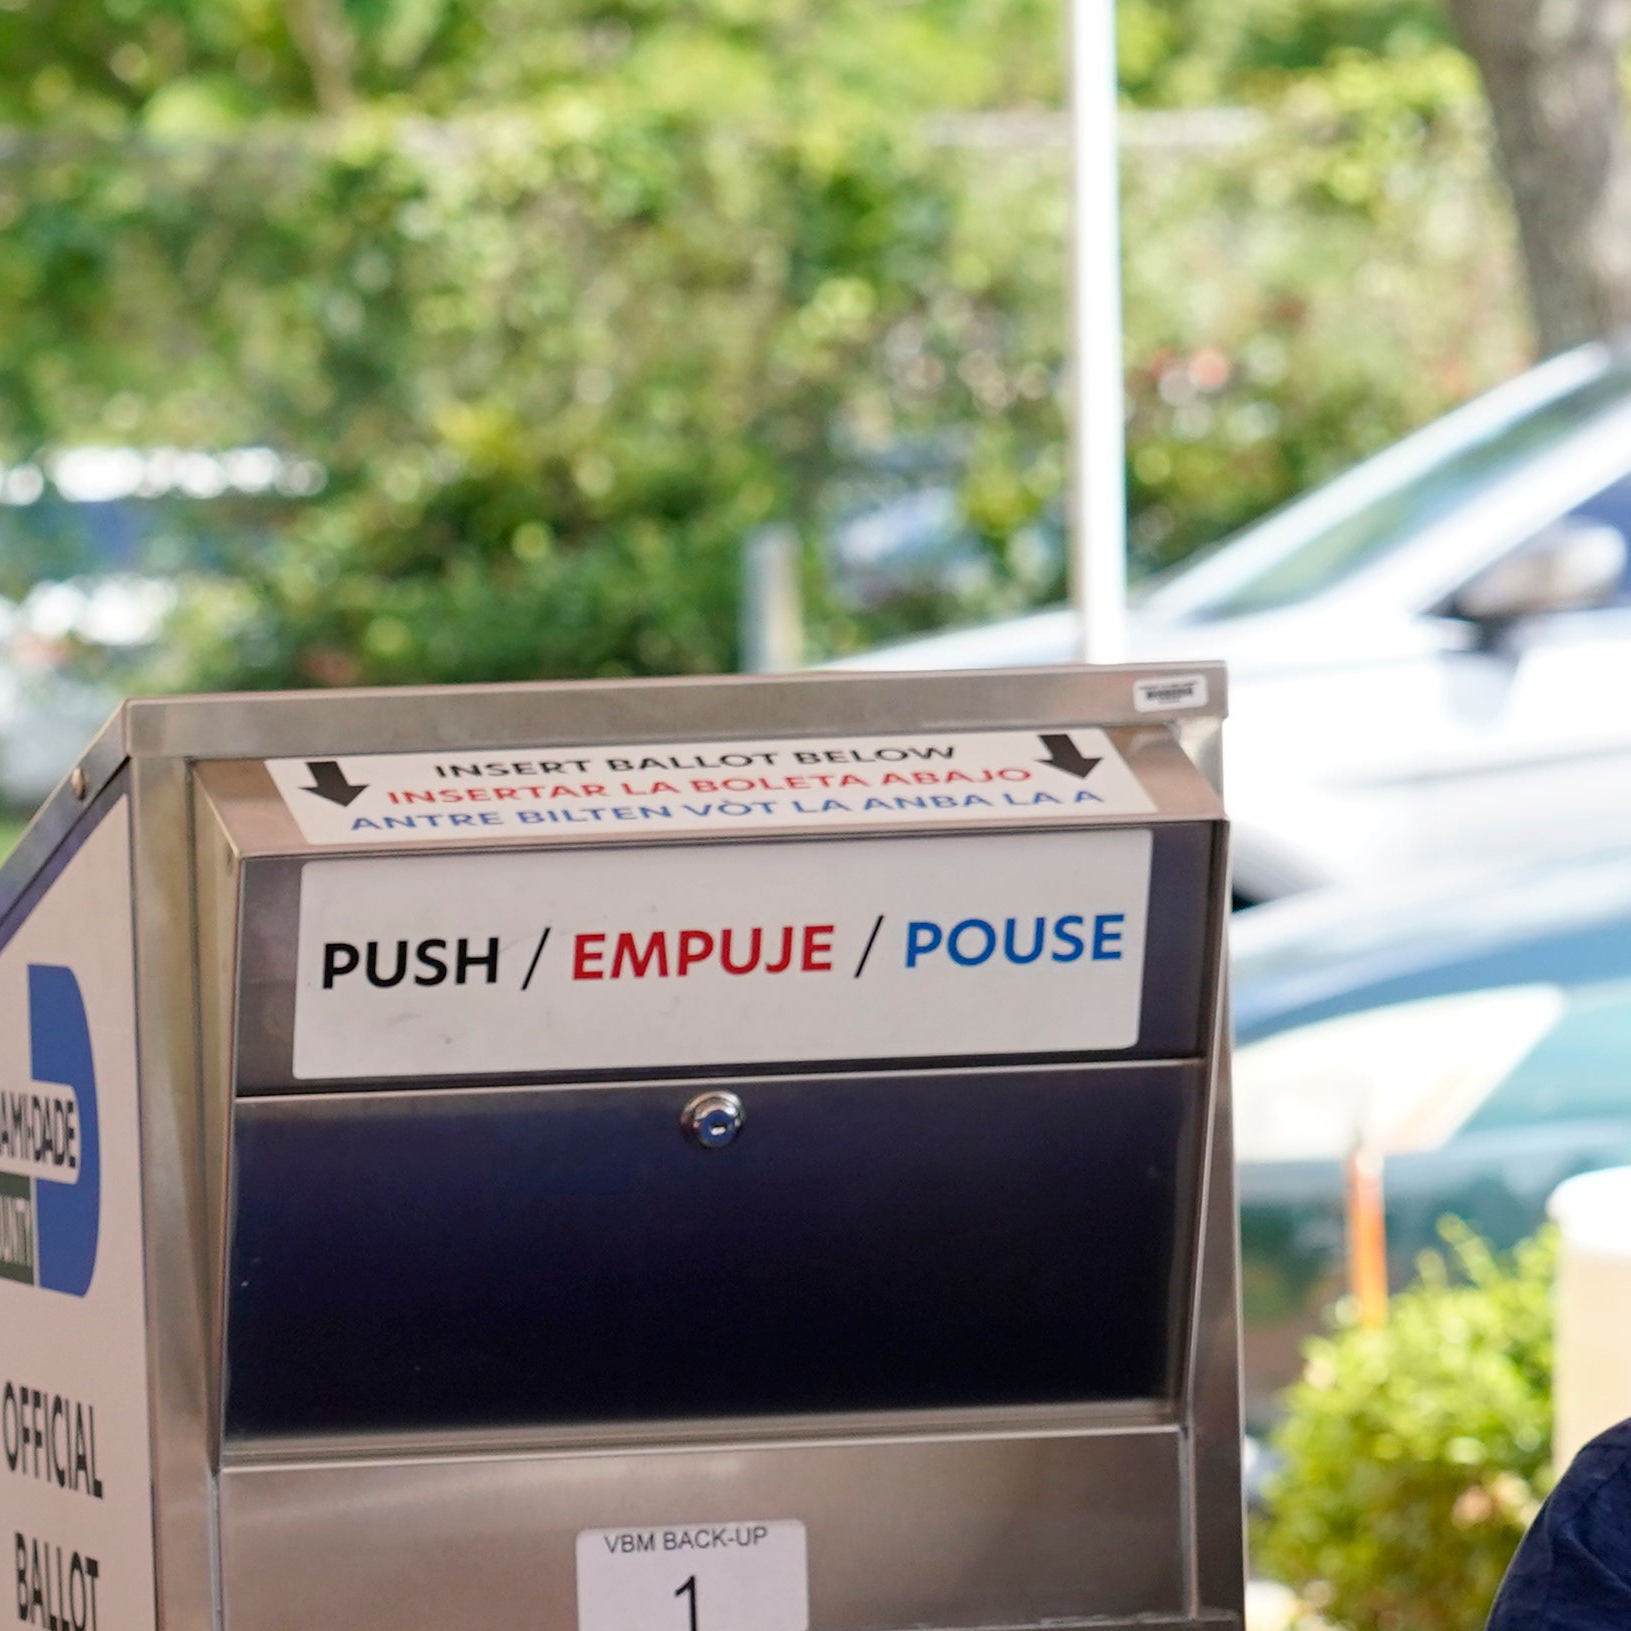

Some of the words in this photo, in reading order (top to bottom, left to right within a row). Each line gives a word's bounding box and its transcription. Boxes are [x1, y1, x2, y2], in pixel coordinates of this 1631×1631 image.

[435, 759, 591, 778] INSERT
[605, 752, 779, 772] BALLOT
[794, 745, 957, 765] BELOW
[387, 782, 607, 805] INSERTAR
[623, 779, 681, 796] LA
[689, 771, 870, 794] BOLETA
[881, 766, 1033, 788] ABAJO
[350, 810, 504, 832] ANTRE
[517, 804, 673, 825] BILTEN
[791, 797, 852, 814] LA
[861, 792, 995, 812] ANBA
[1003, 790, 1066, 807] LA
[1072, 789, 1107, 804] A
[322, 936, 500, 990] PUSH
[571, 925, 836, 982] EMPUJE
[904, 912, 1126, 970] POUSE
[1, 1378, 104, 1499] OFFICIAL
[604, 1533, 656, 1554] VBM
[662, 1525, 768, 1552] BACK-UP
